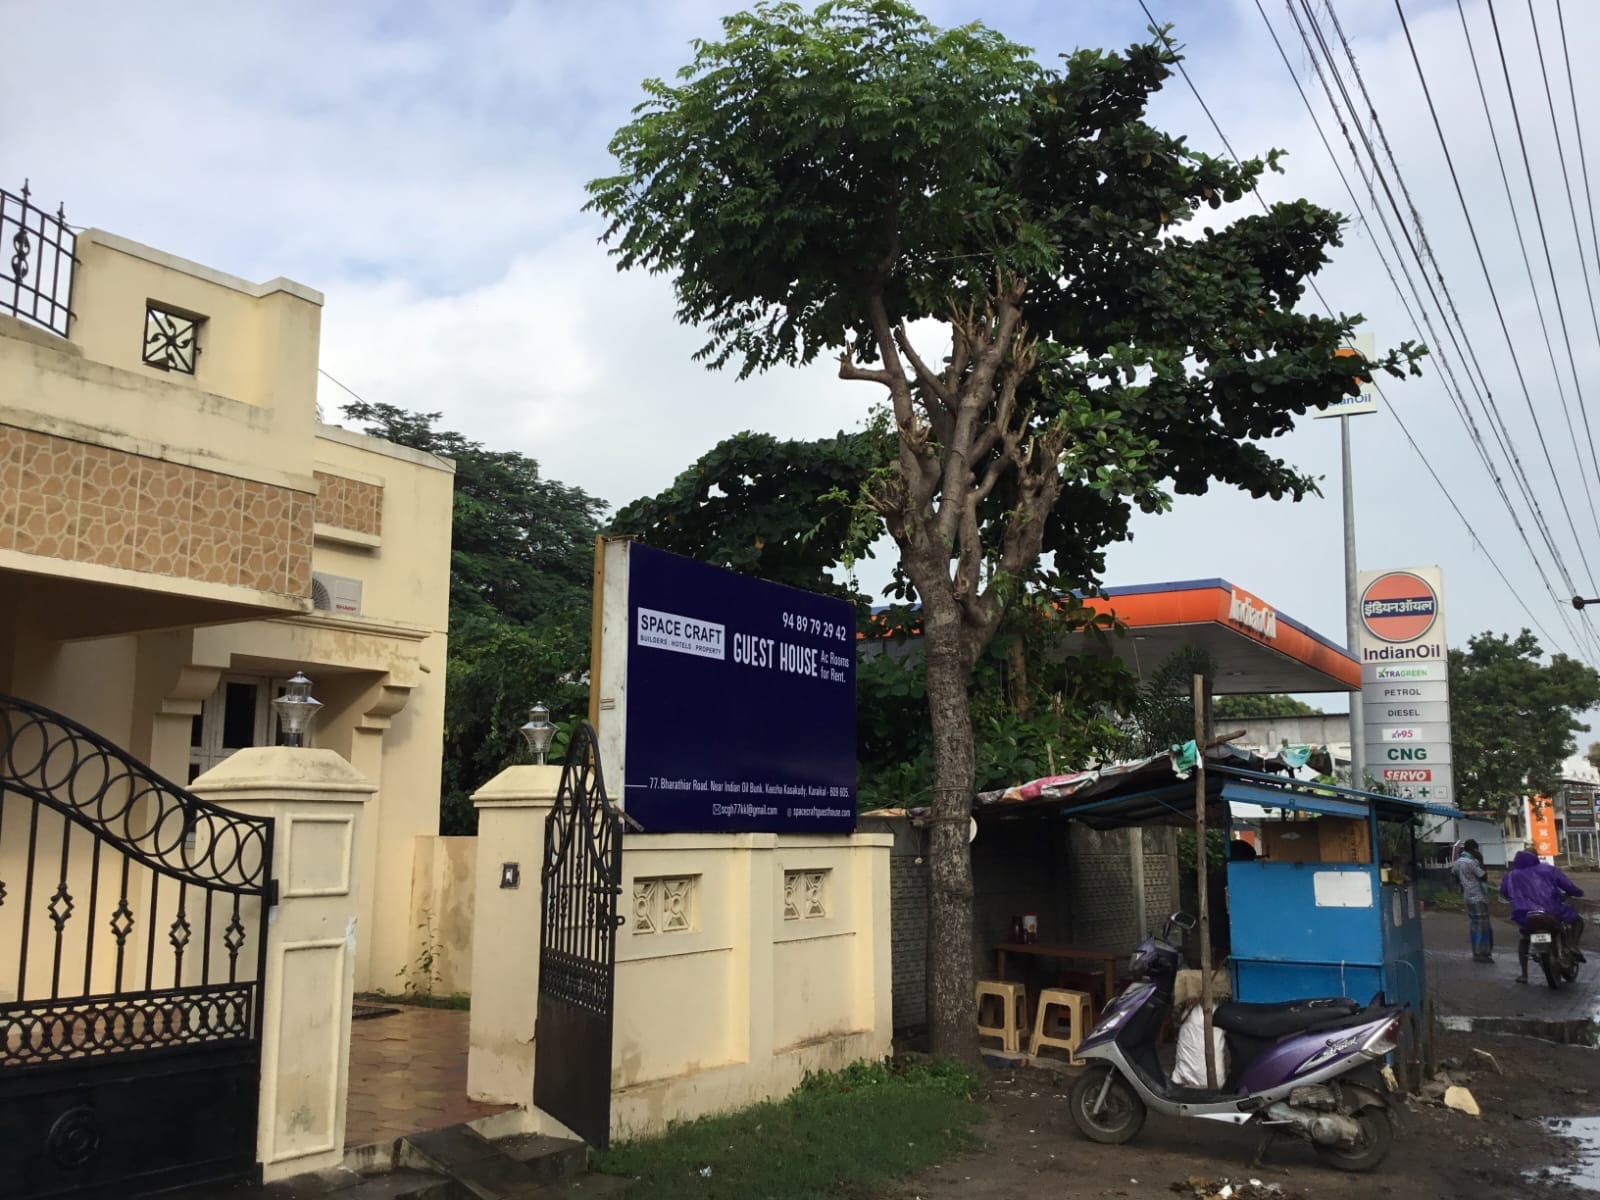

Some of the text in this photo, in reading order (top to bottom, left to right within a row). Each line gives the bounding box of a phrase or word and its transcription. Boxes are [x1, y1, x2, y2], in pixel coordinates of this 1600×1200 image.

[1364, 599, 1433, 616] इंडियनऑयल
[641, 614, 722, 645] SPACE CRAFT
[782, 611, 847, 641] 94 89 79 29 42
[733, 632, 818, 677] GUEST HOUSE
[830, 651, 850, 668] Rooms
[1364, 644, 1440, 660] IndianOil
[820, 666, 830, 680] for
[1384, 688, 1422, 697] PETROL
[1387, 709, 1420, 717] DIESEL
[1387, 747, 1427, 761] CNG
[1385, 770, 1427, 781] SERVO
[710, 780, 723, 791] Near
